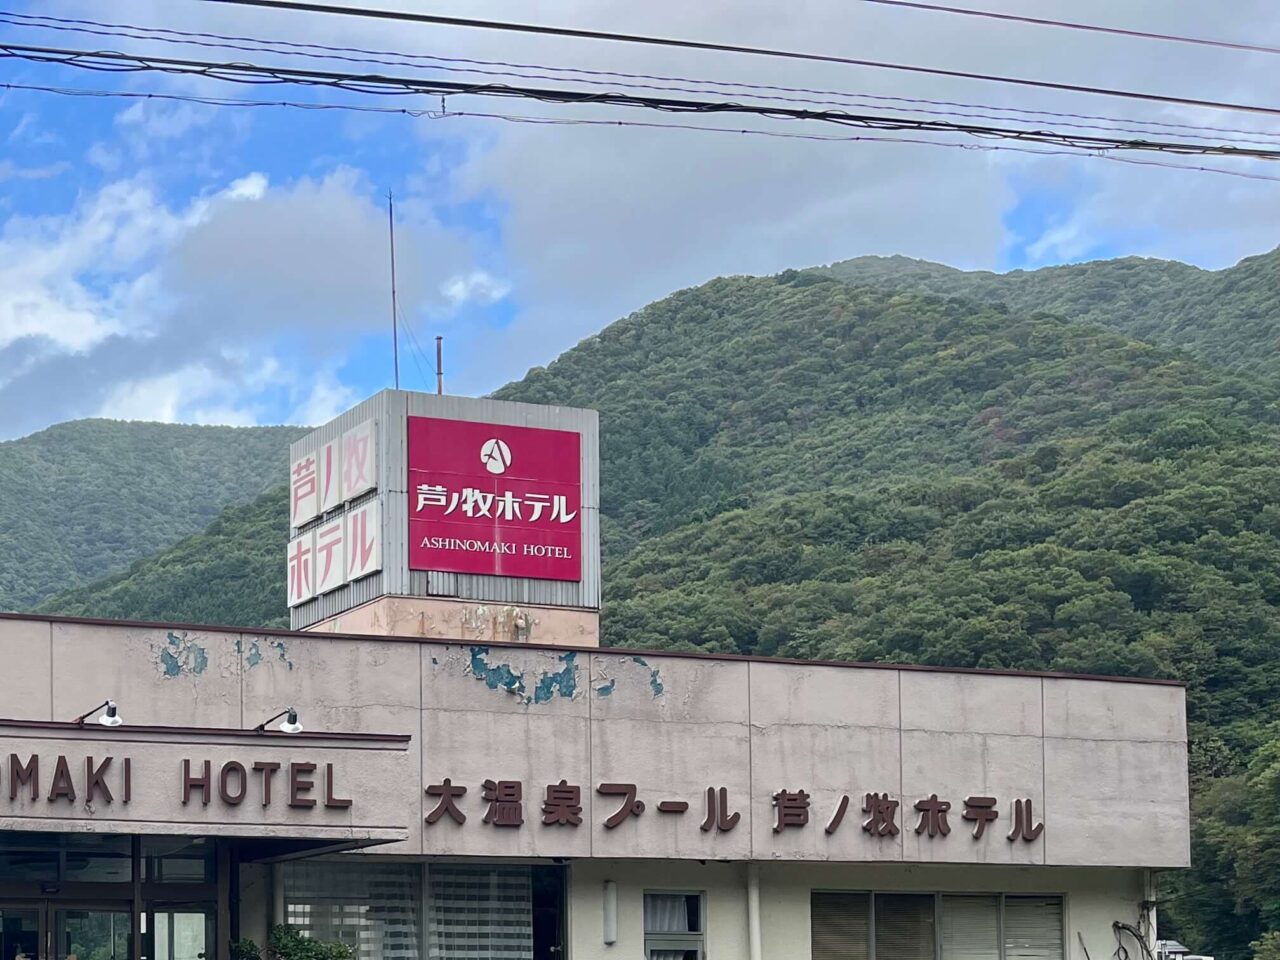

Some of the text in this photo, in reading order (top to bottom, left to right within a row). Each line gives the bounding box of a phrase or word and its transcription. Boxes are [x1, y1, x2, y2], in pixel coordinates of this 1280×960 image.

[415, 484, 577, 524] 芦ノ牧ホテル
[288, 507, 375, 601] ホテル
[420, 536, 572, 559] ASHINOMAKI HOTEL
[182, 757, 354, 808] HOTEL
[424, 777, 1046, 843] 大温泉プール 芦ノ牧ホテル
